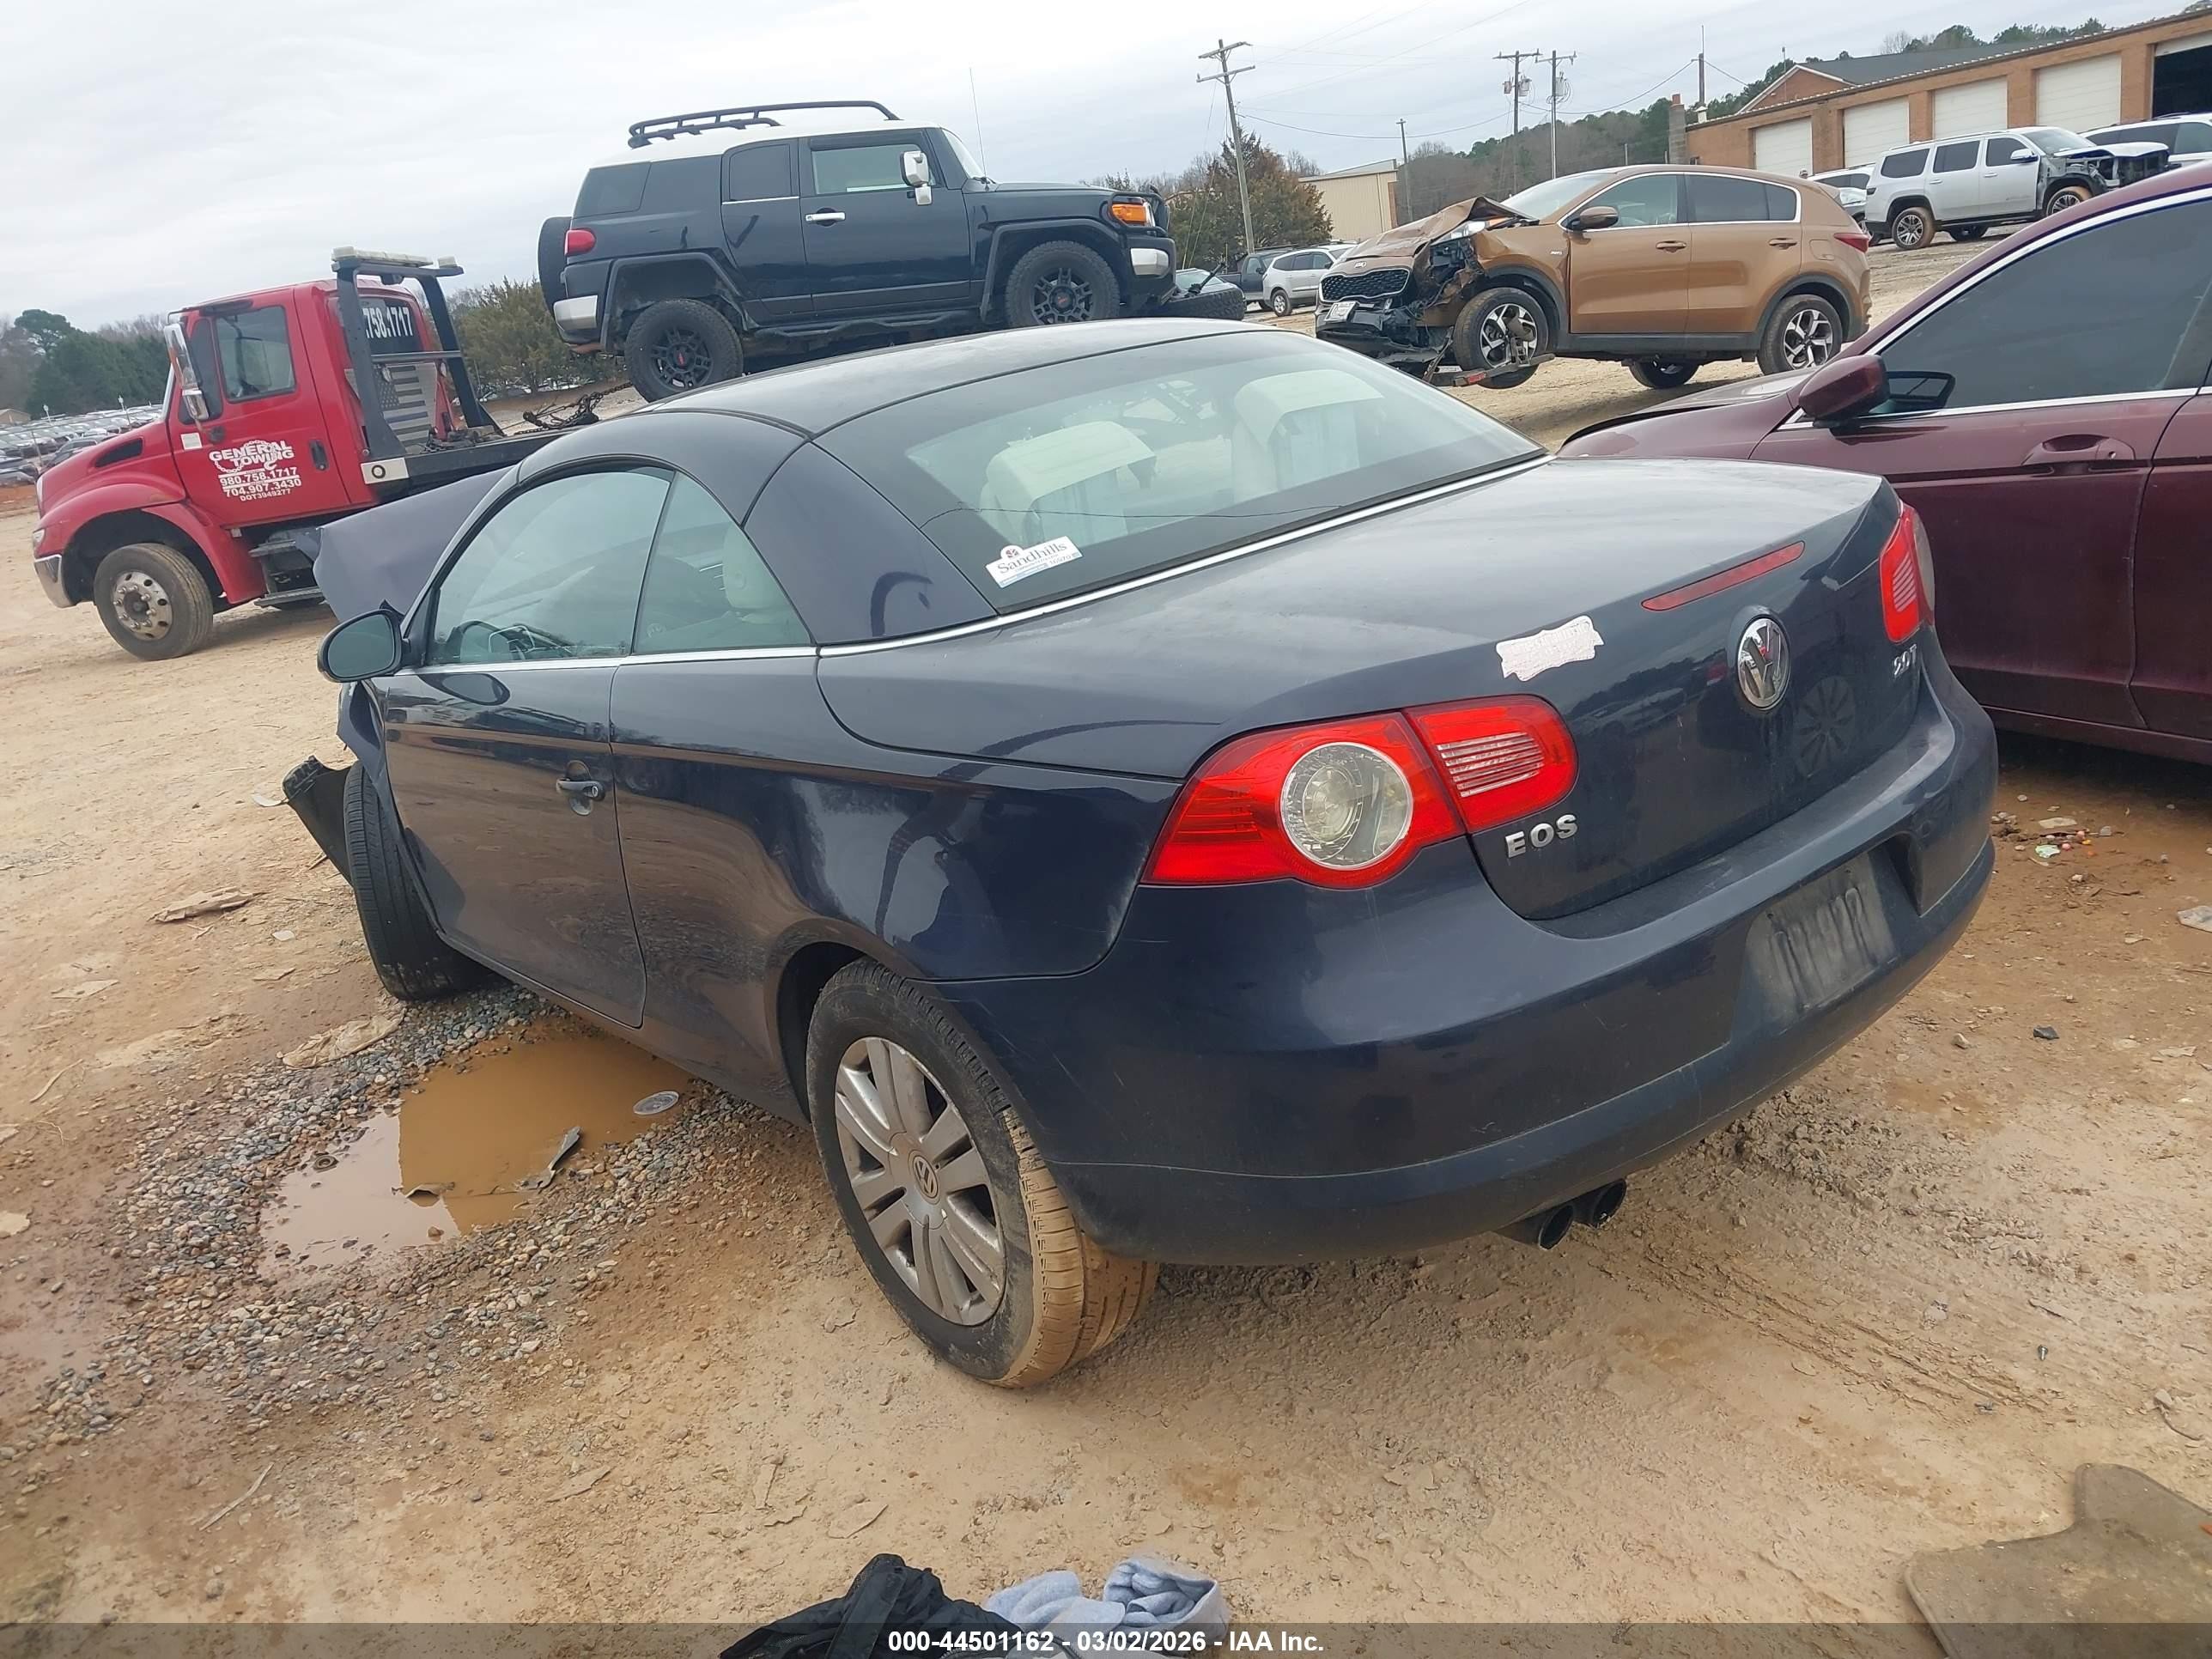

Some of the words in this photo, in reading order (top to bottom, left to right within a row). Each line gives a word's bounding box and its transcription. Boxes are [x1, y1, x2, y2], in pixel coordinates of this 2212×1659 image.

[209, 441, 292, 461] GENERAL
[229, 449, 295, 466] TOWING
[220, 467, 297, 486] 980.758.1717
[223, 478, 302, 497] 704.907.3430
[240, 488, 291, 501] DOT3949277
[997, 543, 1067, 574] Sandhills
[1505, 814, 1578, 858] EOS
